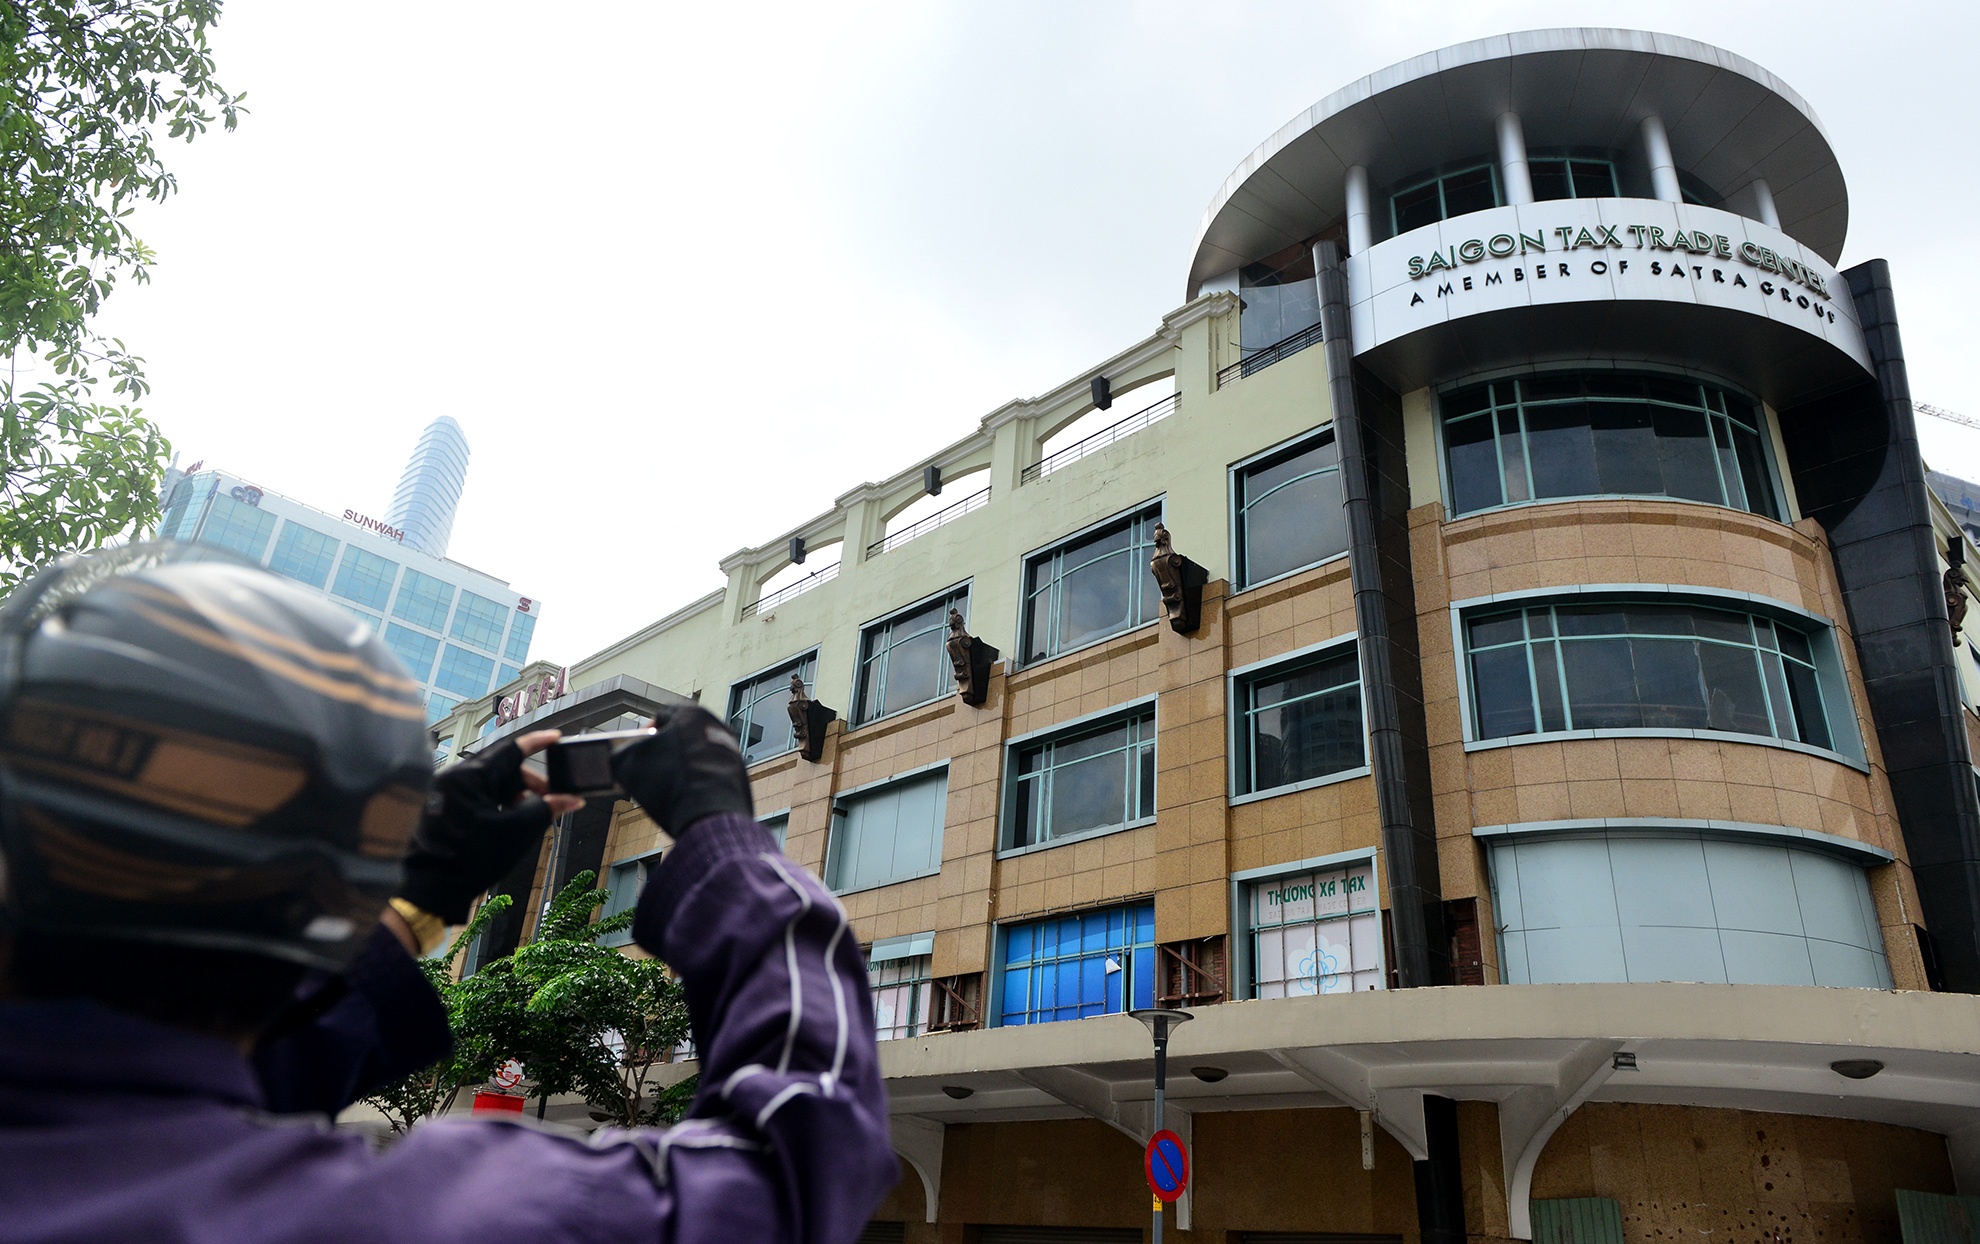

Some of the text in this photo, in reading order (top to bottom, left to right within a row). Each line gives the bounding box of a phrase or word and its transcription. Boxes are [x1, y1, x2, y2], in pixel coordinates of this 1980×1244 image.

[1407, 224, 1832, 301] SAIGON TAX TRADE CENTER
[1410, 260, 1836, 324] A MEMBER OF SATRA GROUP
[343, 509, 405, 542] SUNWAH
[495, 667, 570, 728] SATRA
[1315, 901, 1336, 911] RADE
[1341, 875, 1366, 894] TAX
